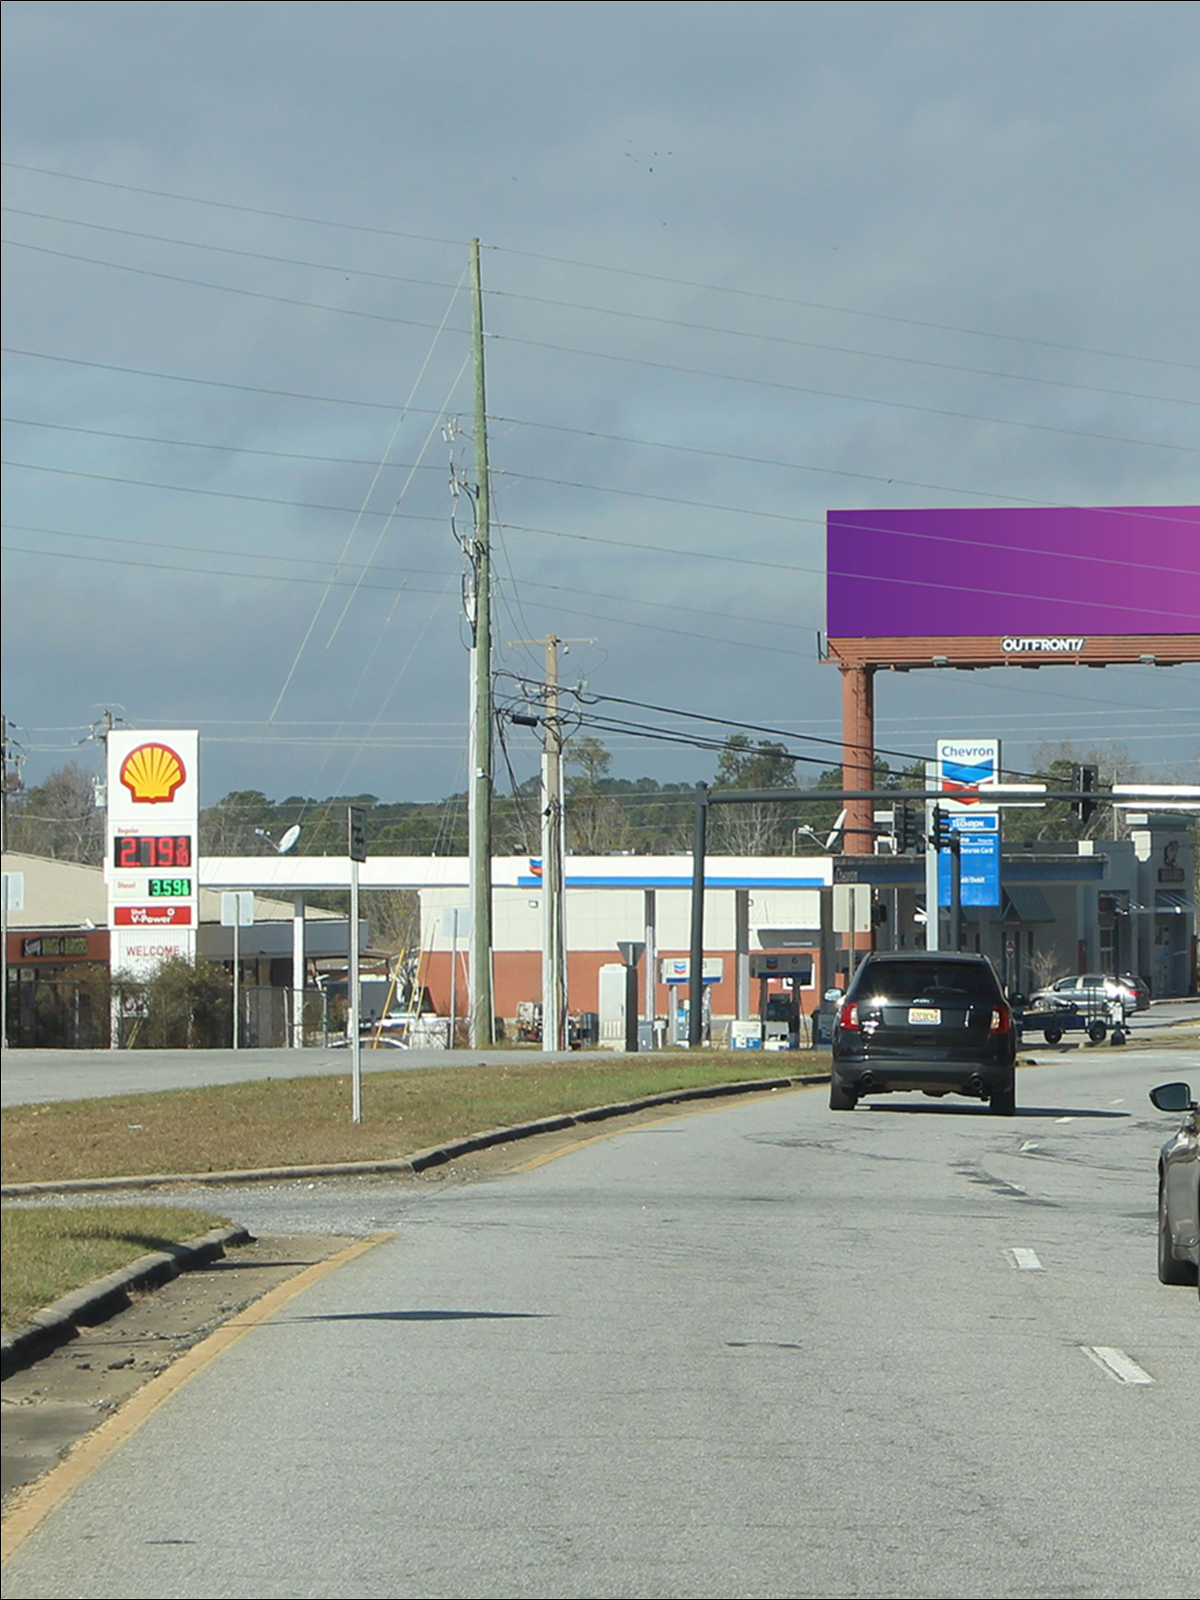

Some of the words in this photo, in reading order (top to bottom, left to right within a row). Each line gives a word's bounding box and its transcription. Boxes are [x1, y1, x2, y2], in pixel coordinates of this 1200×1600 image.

[942, 745, 994, 756] Chevron
[130, 915, 172, 923] V-Power
[126, 945, 180, 957] WELCOME
